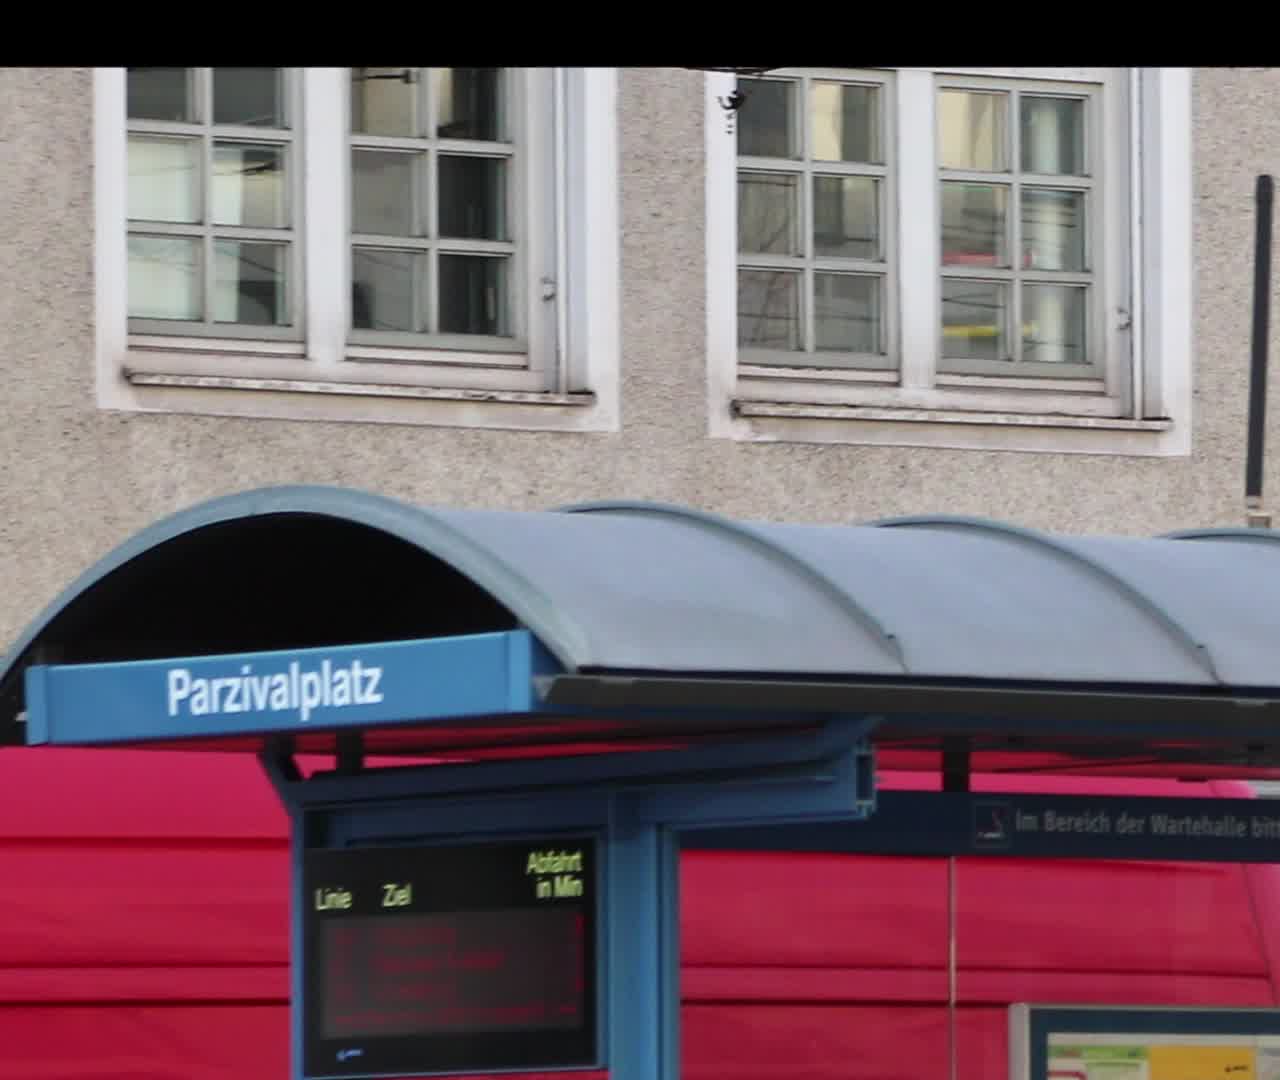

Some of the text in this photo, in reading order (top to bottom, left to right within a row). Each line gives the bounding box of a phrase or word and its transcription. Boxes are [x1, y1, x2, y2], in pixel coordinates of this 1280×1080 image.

[168, 659, 384, 721] Parzivalplatz
[1016, 809, 1038, 833] Im
[1045, 809, 1111, 833] Bereich
[1116, 811, 1145, 834] der
[1151, 813, 1248, 838] Wartehalle
[526, 850, 582, 875] Abfahrt
[315, 884, 411, 910] Linie Ziel
[536, 875, 583, 898] in Min
